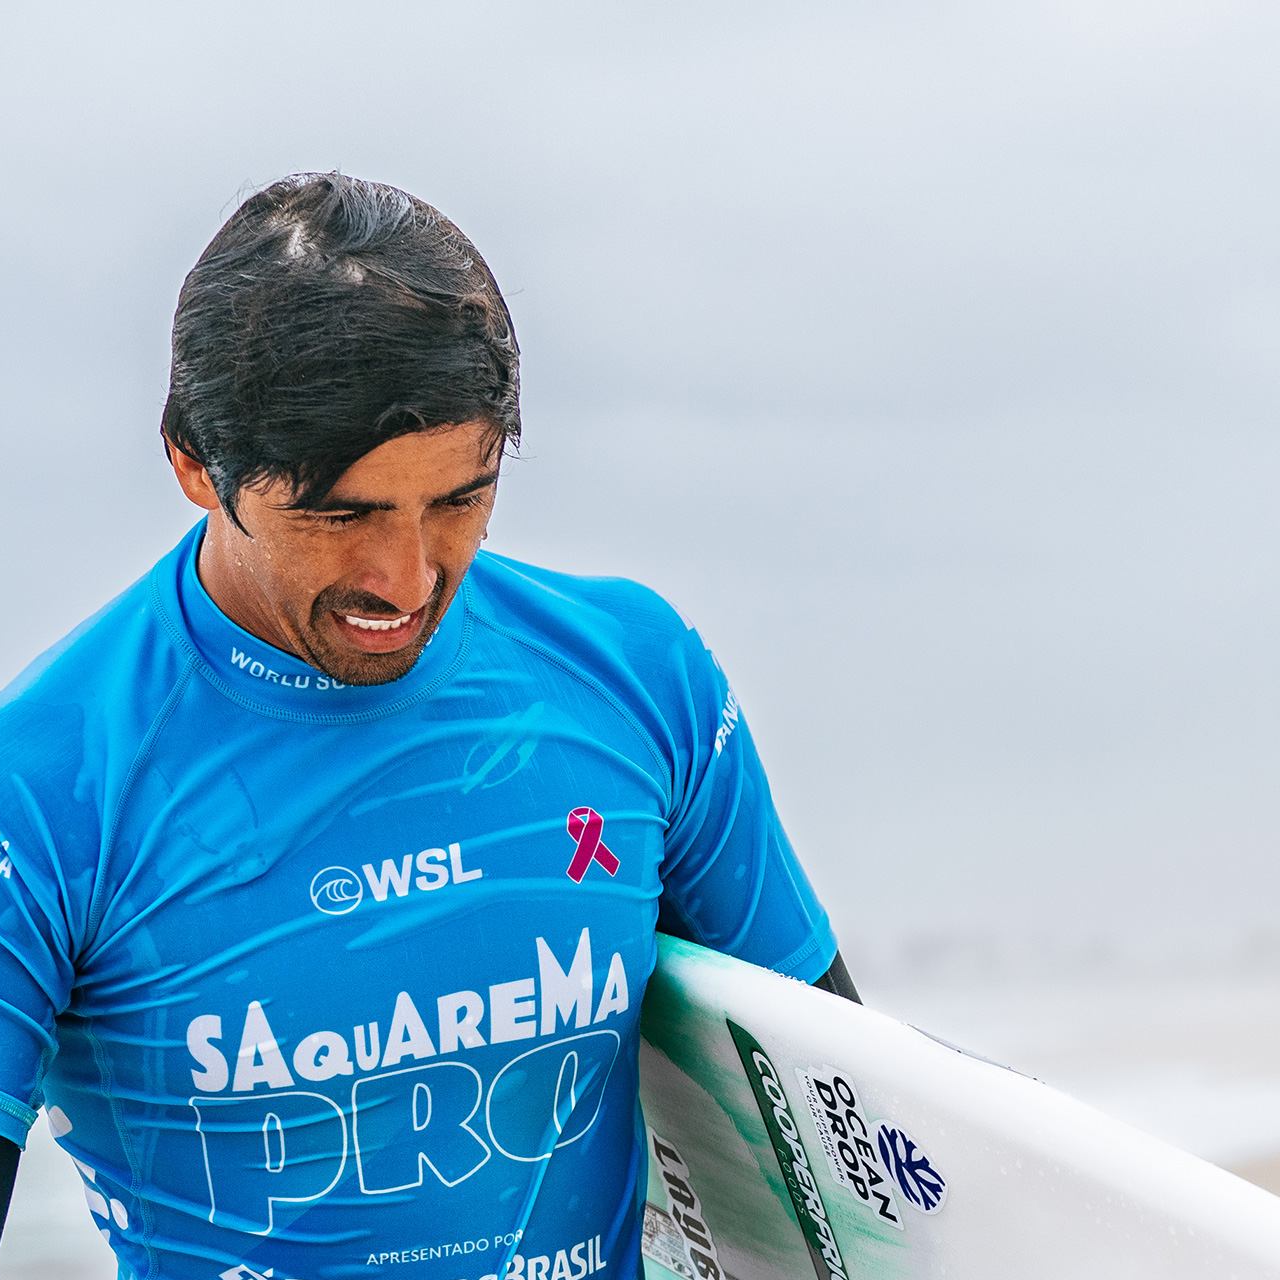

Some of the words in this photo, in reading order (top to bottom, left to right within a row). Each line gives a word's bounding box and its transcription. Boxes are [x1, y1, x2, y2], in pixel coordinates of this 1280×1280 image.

[231, 647, 310, 689] WORLD
[316, 675, 354, 691] SU
[715, 681, 739, 758] BANC
[361, 842, 483, 902] WSL
[186, 927, 629, 1093] SAQUAREMA
[805, 1075, 818, 1104] YOUR
[189, 1030, 620, 1236] PRO
[806, 1095, 818, 1118] OUR
[816, 1121, 832, 1159] CAUSE
[813, 1078, 870, 1200] DROP
[833, 1076, 899, 1223] OCEAN
[777, 1148, 808, 1216] FOODS
[366, 1238, 490, 1266] APRESENTADO
[494, 1229, 524, 1248] POR
